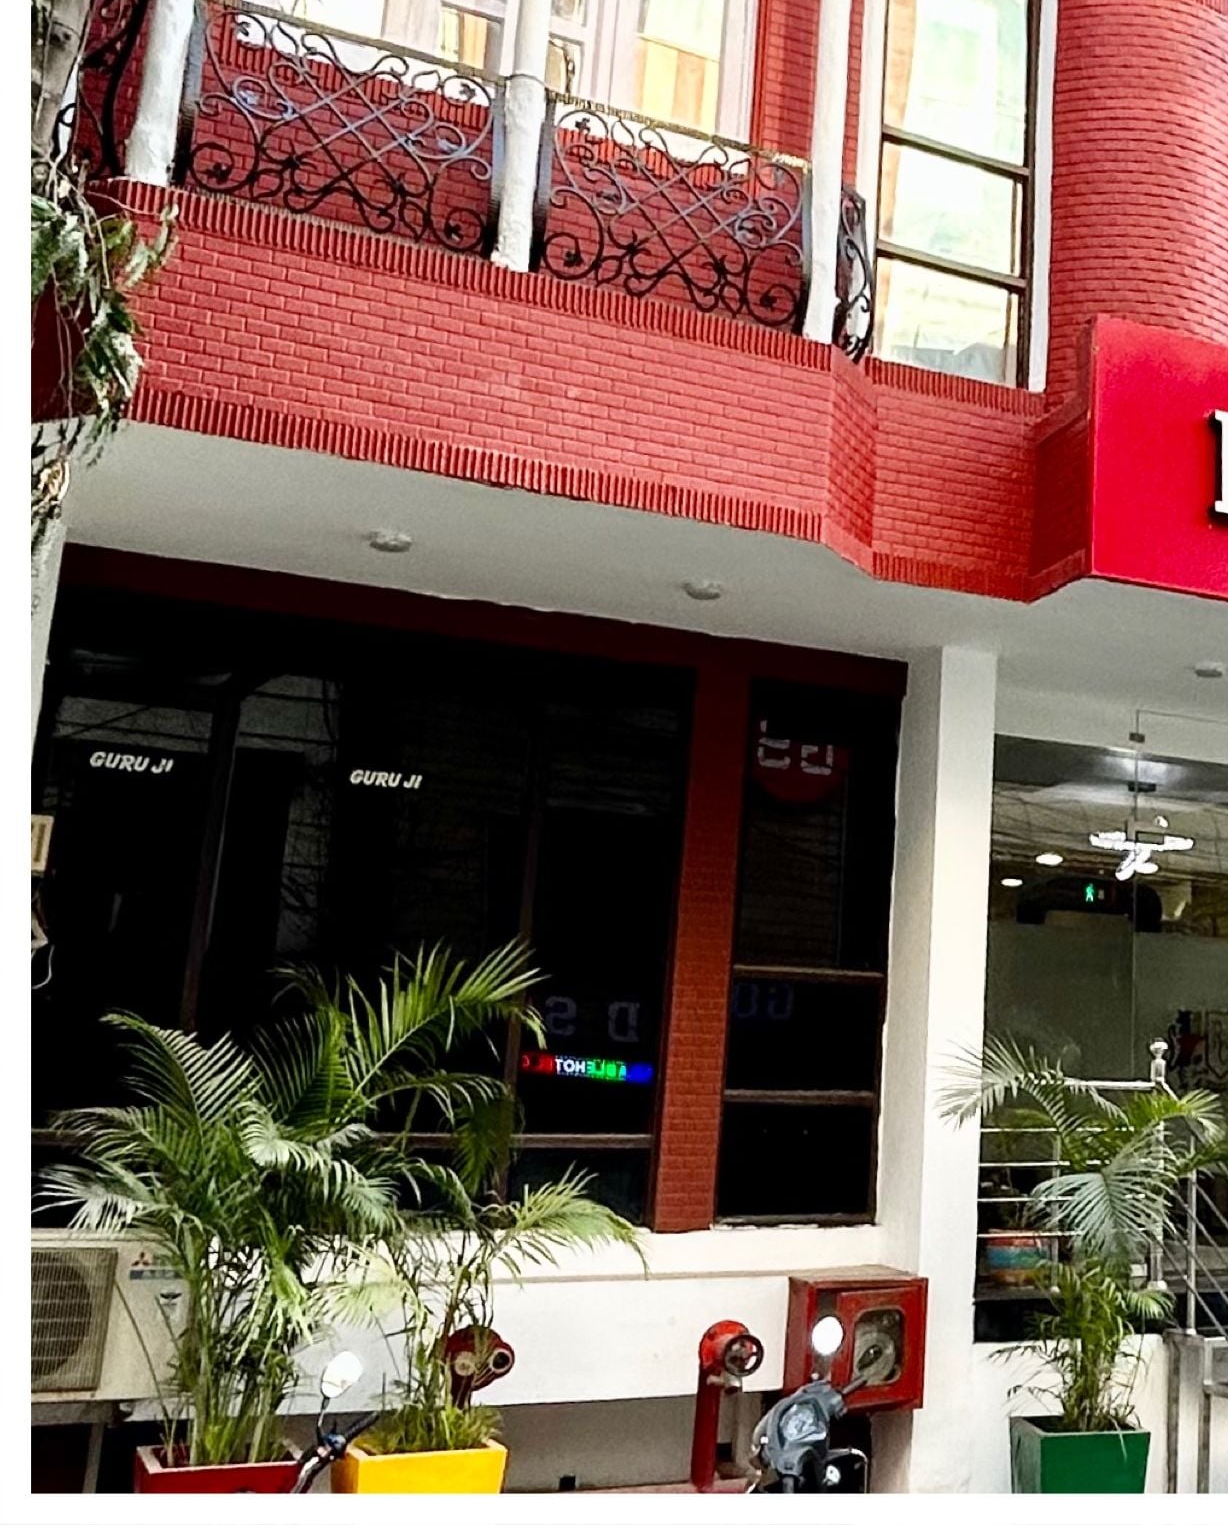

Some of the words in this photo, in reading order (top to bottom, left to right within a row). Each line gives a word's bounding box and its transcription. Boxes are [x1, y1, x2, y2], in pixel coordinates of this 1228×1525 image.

[90, 751, 149, 773] GURU
[151, 758, 174, 774] JI
[350, 769, 401, 788] GURU
[403, 774, 422, 790] JI
